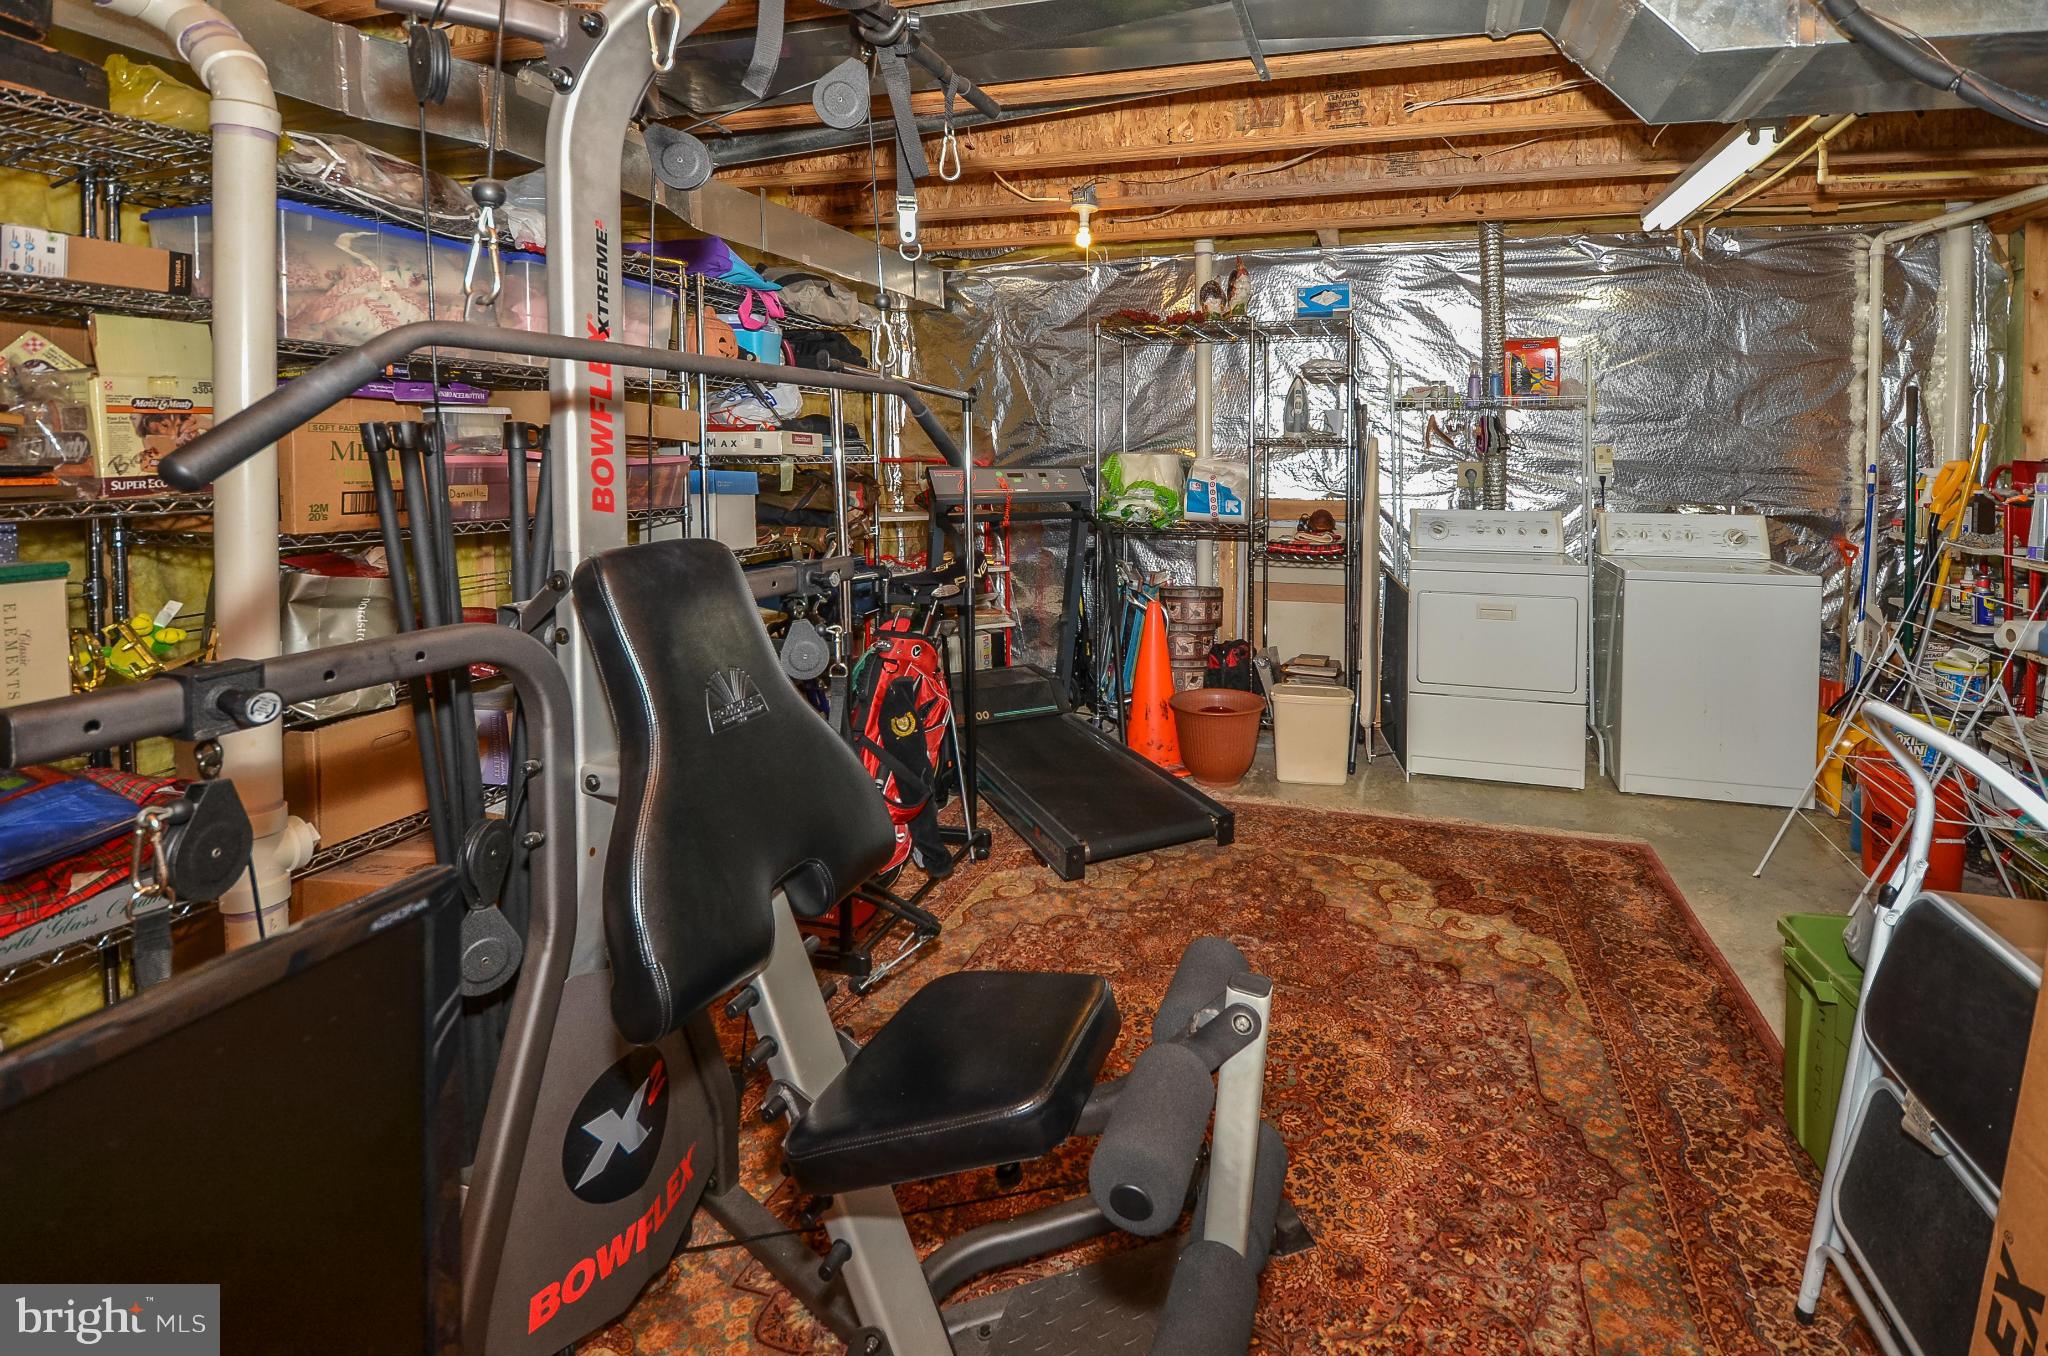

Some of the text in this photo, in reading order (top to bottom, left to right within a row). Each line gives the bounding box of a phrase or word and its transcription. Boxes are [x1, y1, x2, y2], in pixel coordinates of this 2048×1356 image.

[133, 399, 159, 408] Moist
[167, 400, 193, 410] Meaty
[312, 424, 335, 433] SOFT
[706, 437, 737, 448] MAX
[110, 480, 146, 491] SUPER
[308, 503, 329, 512] 12M
[308, 512, 329, 521] 20's
[3, 603, 21, 700] ELEMENTS
[47, 914, 98, 939] Glass
[528, 1141, 696, 1336] BOWFLEX
